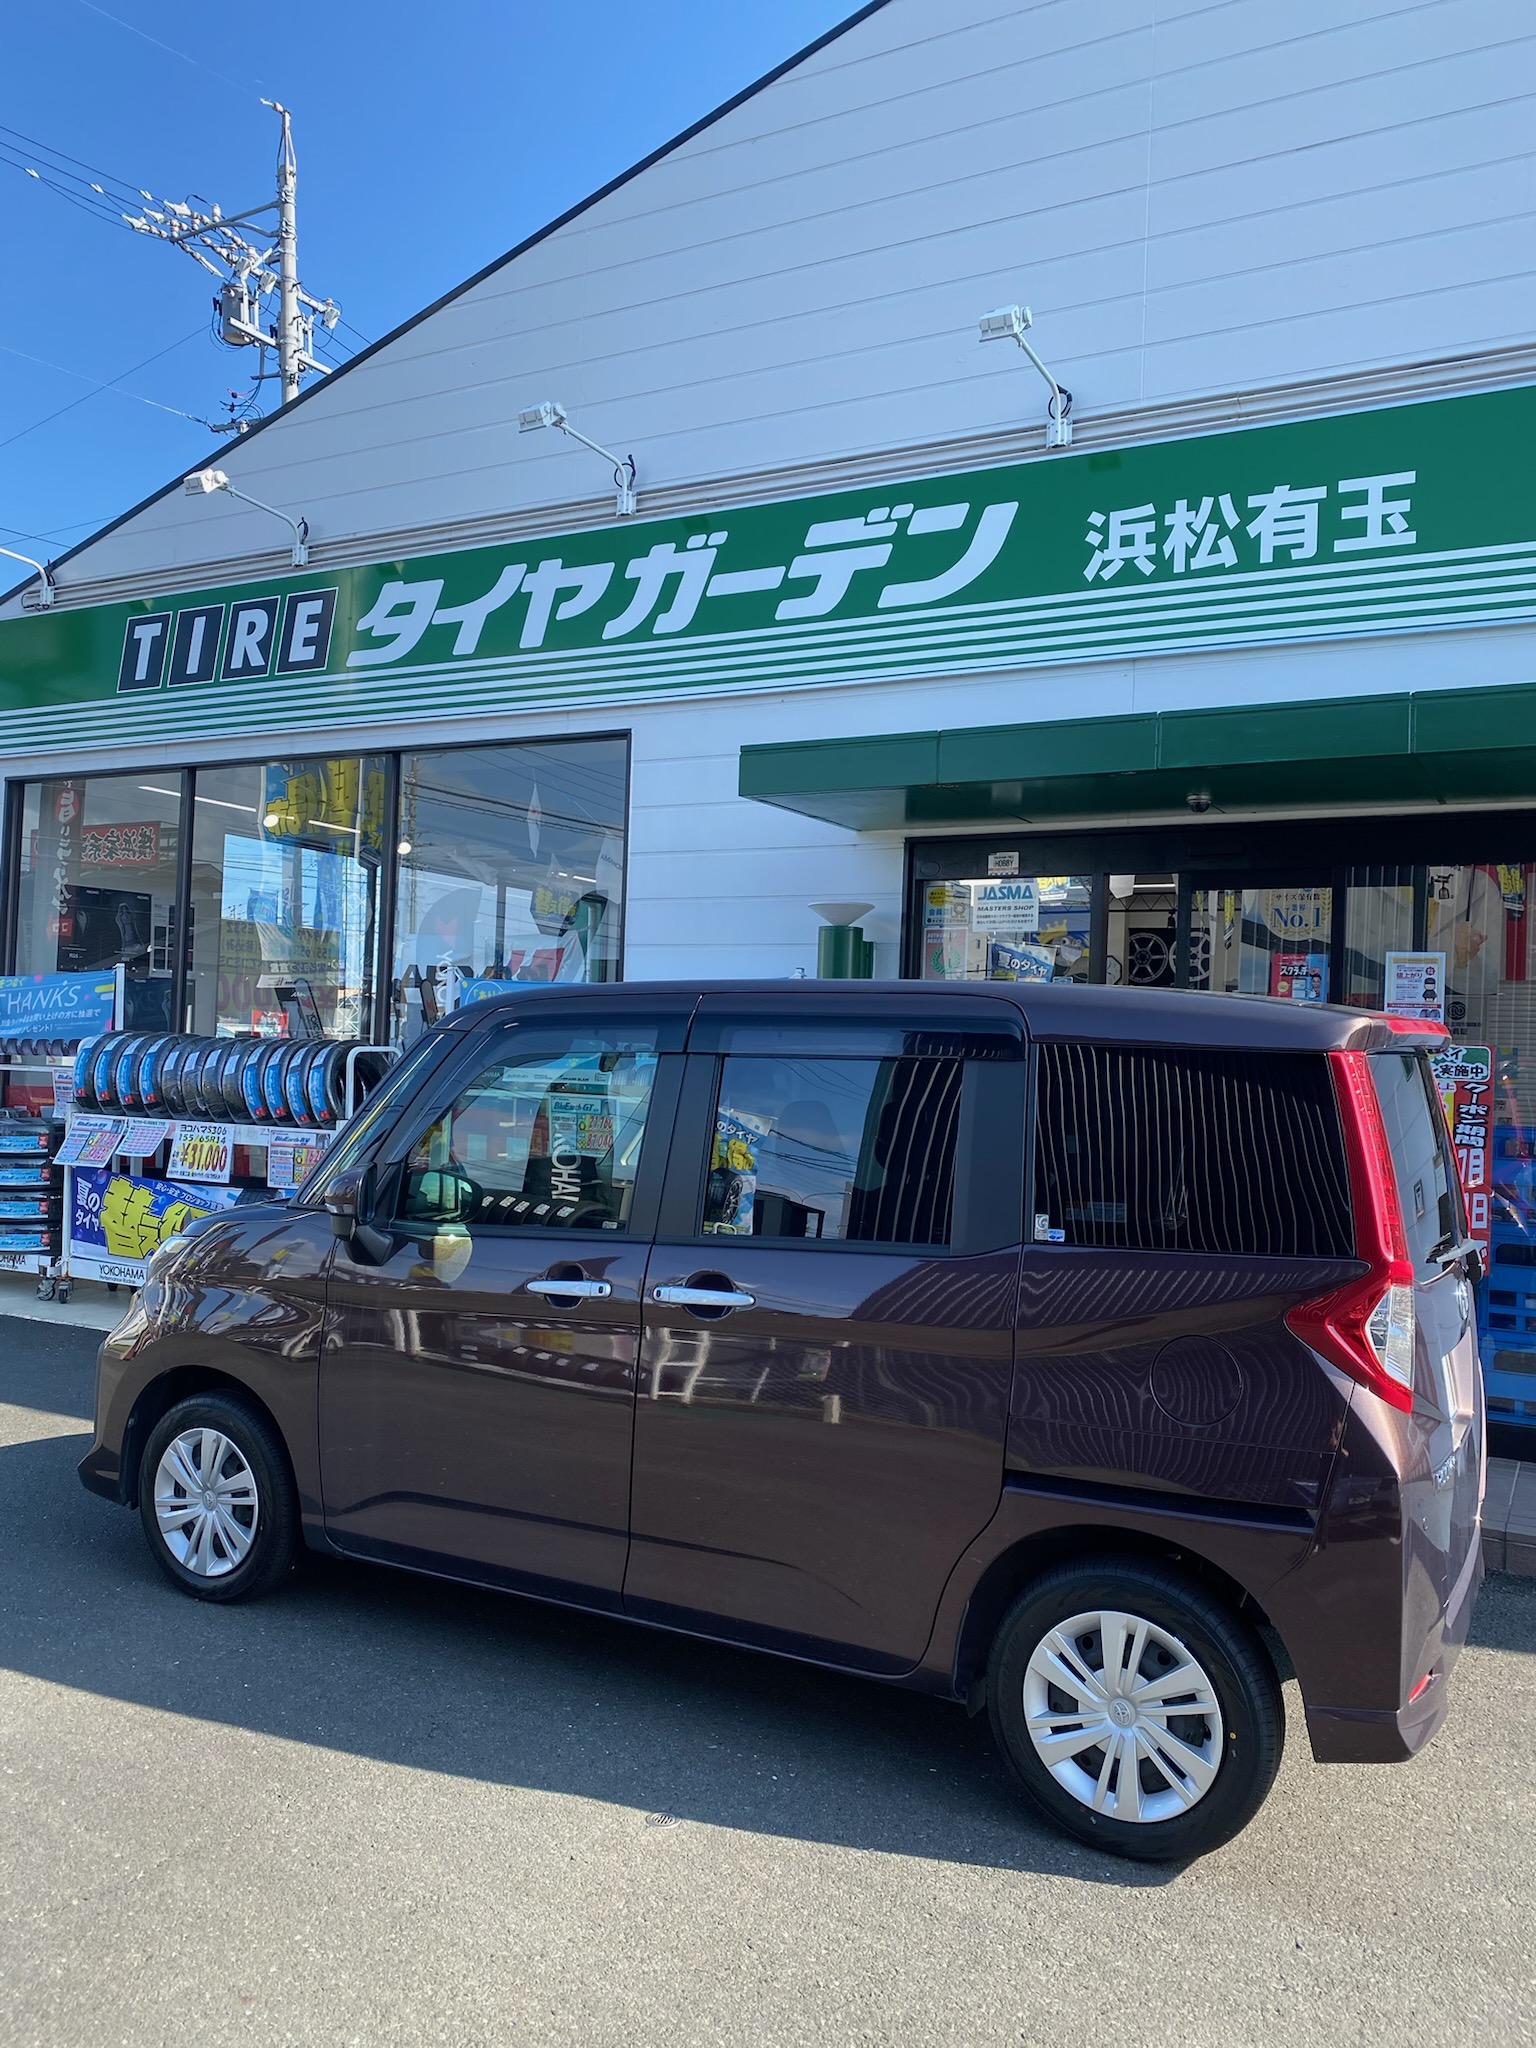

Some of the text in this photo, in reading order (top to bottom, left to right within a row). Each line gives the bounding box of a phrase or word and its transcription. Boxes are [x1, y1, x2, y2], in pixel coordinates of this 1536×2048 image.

[132, 470, 1418, 683] TIRE タイヤガーデン 浜松有玉
[978, 885, 1034, 900] JASMA
[1271, 906, 1322, 928] No.1
[997, 951, 1049, 978] 夏のタイヤ
[99, 1264, 145, 1280] YOKOHAMA
